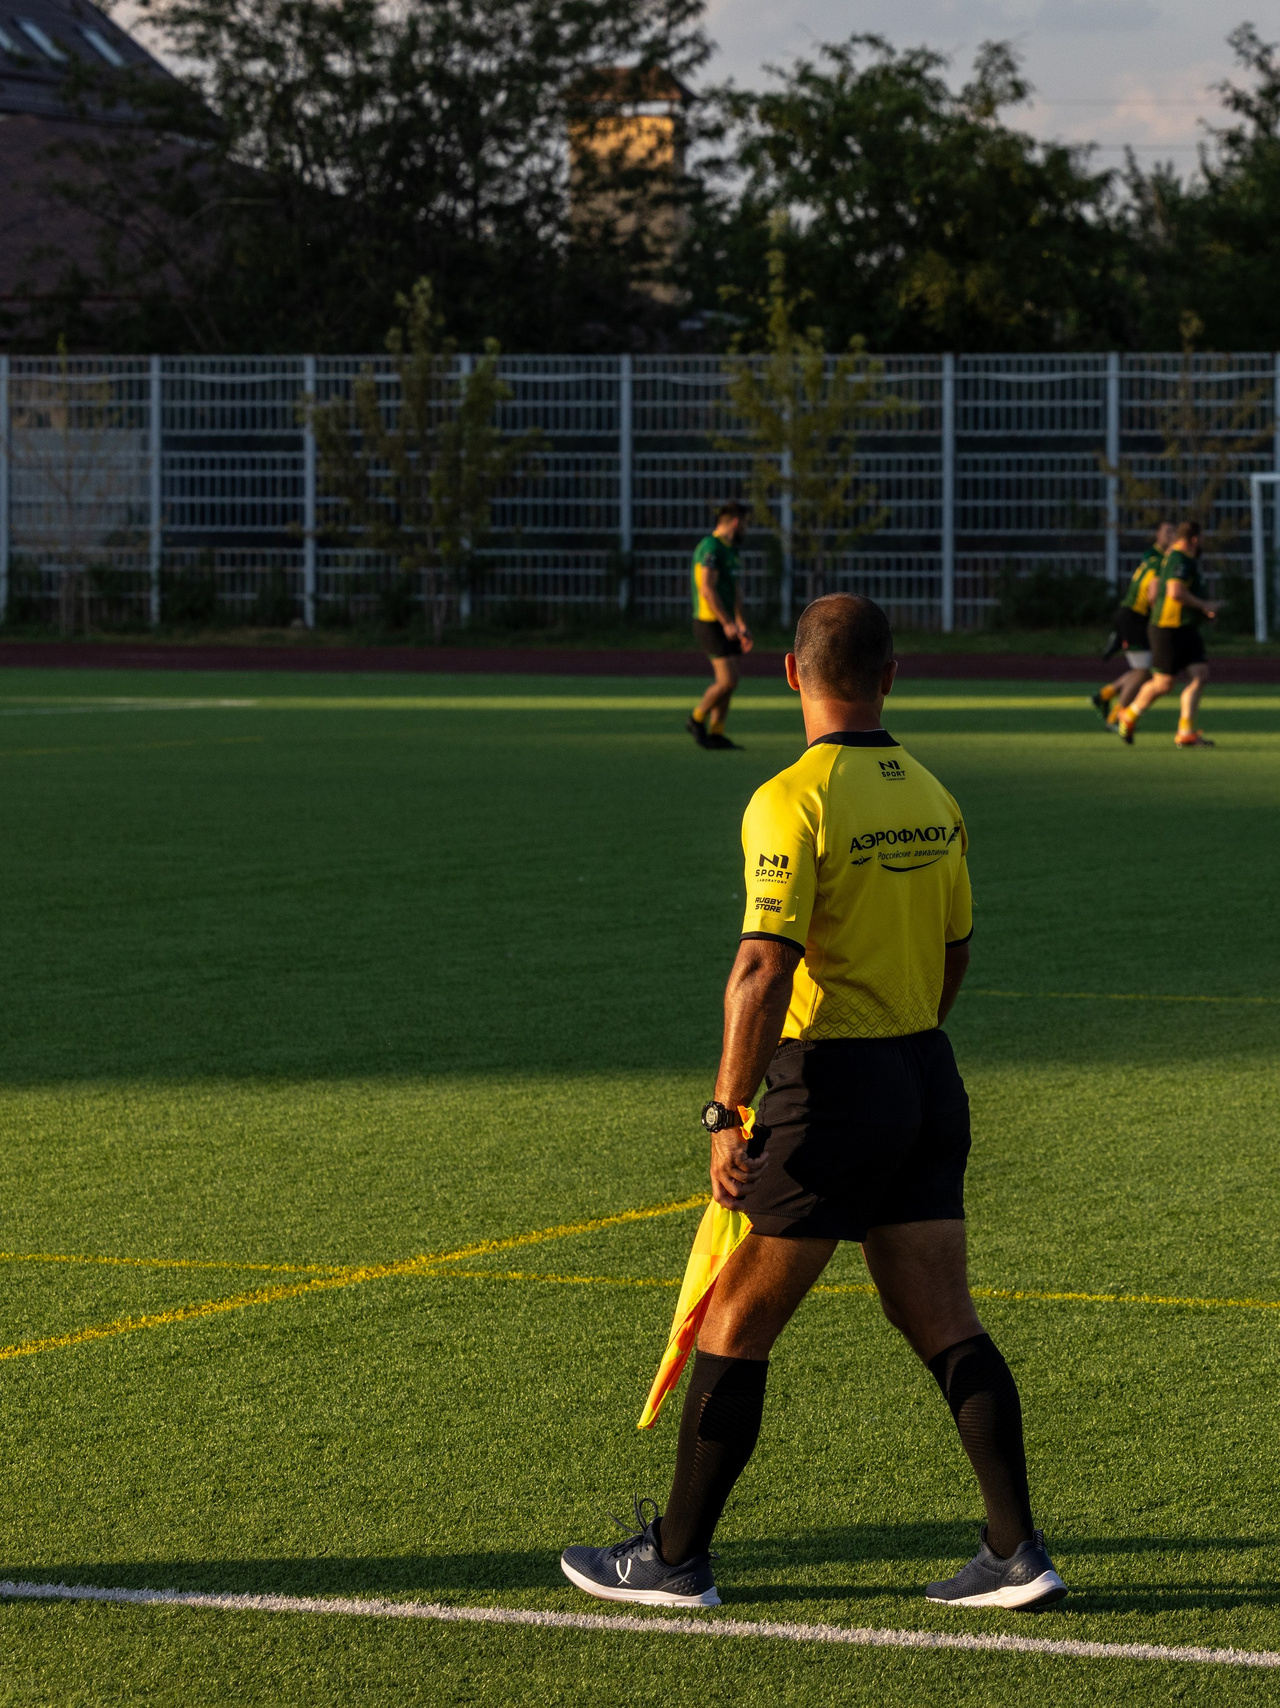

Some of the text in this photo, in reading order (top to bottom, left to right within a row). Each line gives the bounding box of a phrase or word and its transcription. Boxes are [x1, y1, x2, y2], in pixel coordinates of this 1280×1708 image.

[850, 827, 946, 853] АЭРОФЛОТ
[877, 851, 911, 860] Российские
[755, 869, 792, 879] SPORT
[755, 897, 783, 905] RUGBY
[755, 904, 782, 913] STORE
